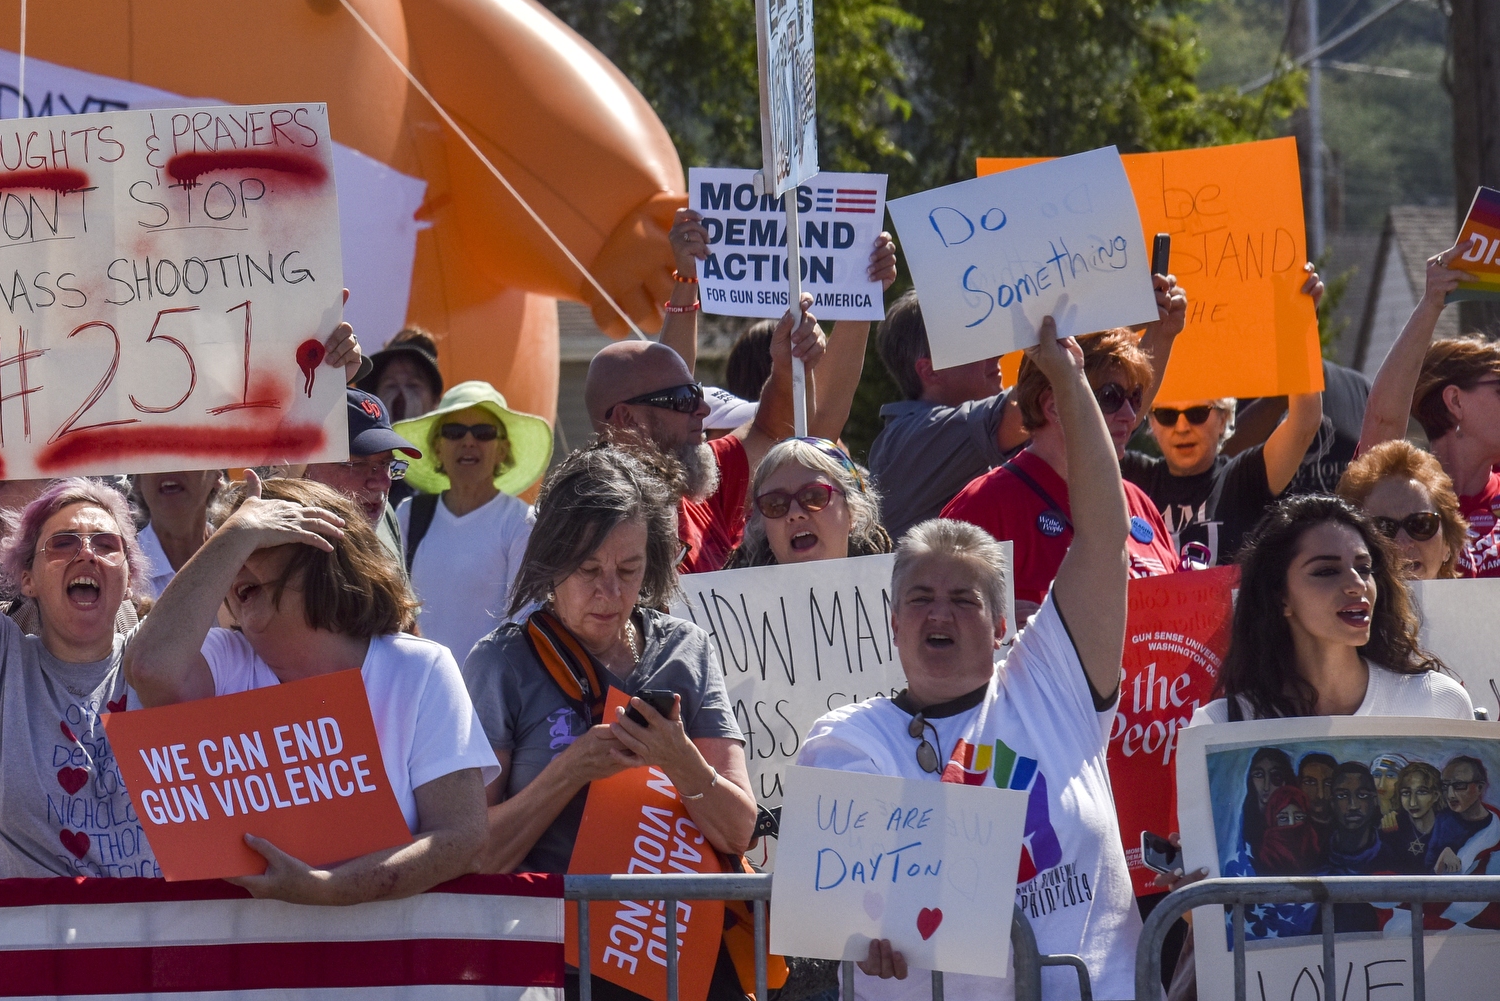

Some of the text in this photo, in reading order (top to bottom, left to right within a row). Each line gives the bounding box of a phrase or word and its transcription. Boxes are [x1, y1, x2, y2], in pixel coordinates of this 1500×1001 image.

[128, 178, 266, 229] STOP
[1162, 158, 1228, 220] be
[929, 206, 1007, 248] Do
[104, 250, 316, 306] SHOOTING
[706, 287, 872, 308] FOR GUN SENS AMERICA
[962, 235, 1128, 328] Something
[1131, 631, 1223, 668] GUN SENSE UNIVERSI
[1148, 642, 1206, 667] WASHINGTON
[1131, 662, 1190, 715] the
[139, 716, 345, 784] WE CAN END
[733, 698, 799, 760] ASS
[1108, 700, 1199, 766] Peop
[47, 794, 139, 829] NICHOL
[139, 754, 377, 825] GUN VIOLENCE
[887, 807, 934, 831] ARE
[602, 804, 674, 976] VIOLNCE
